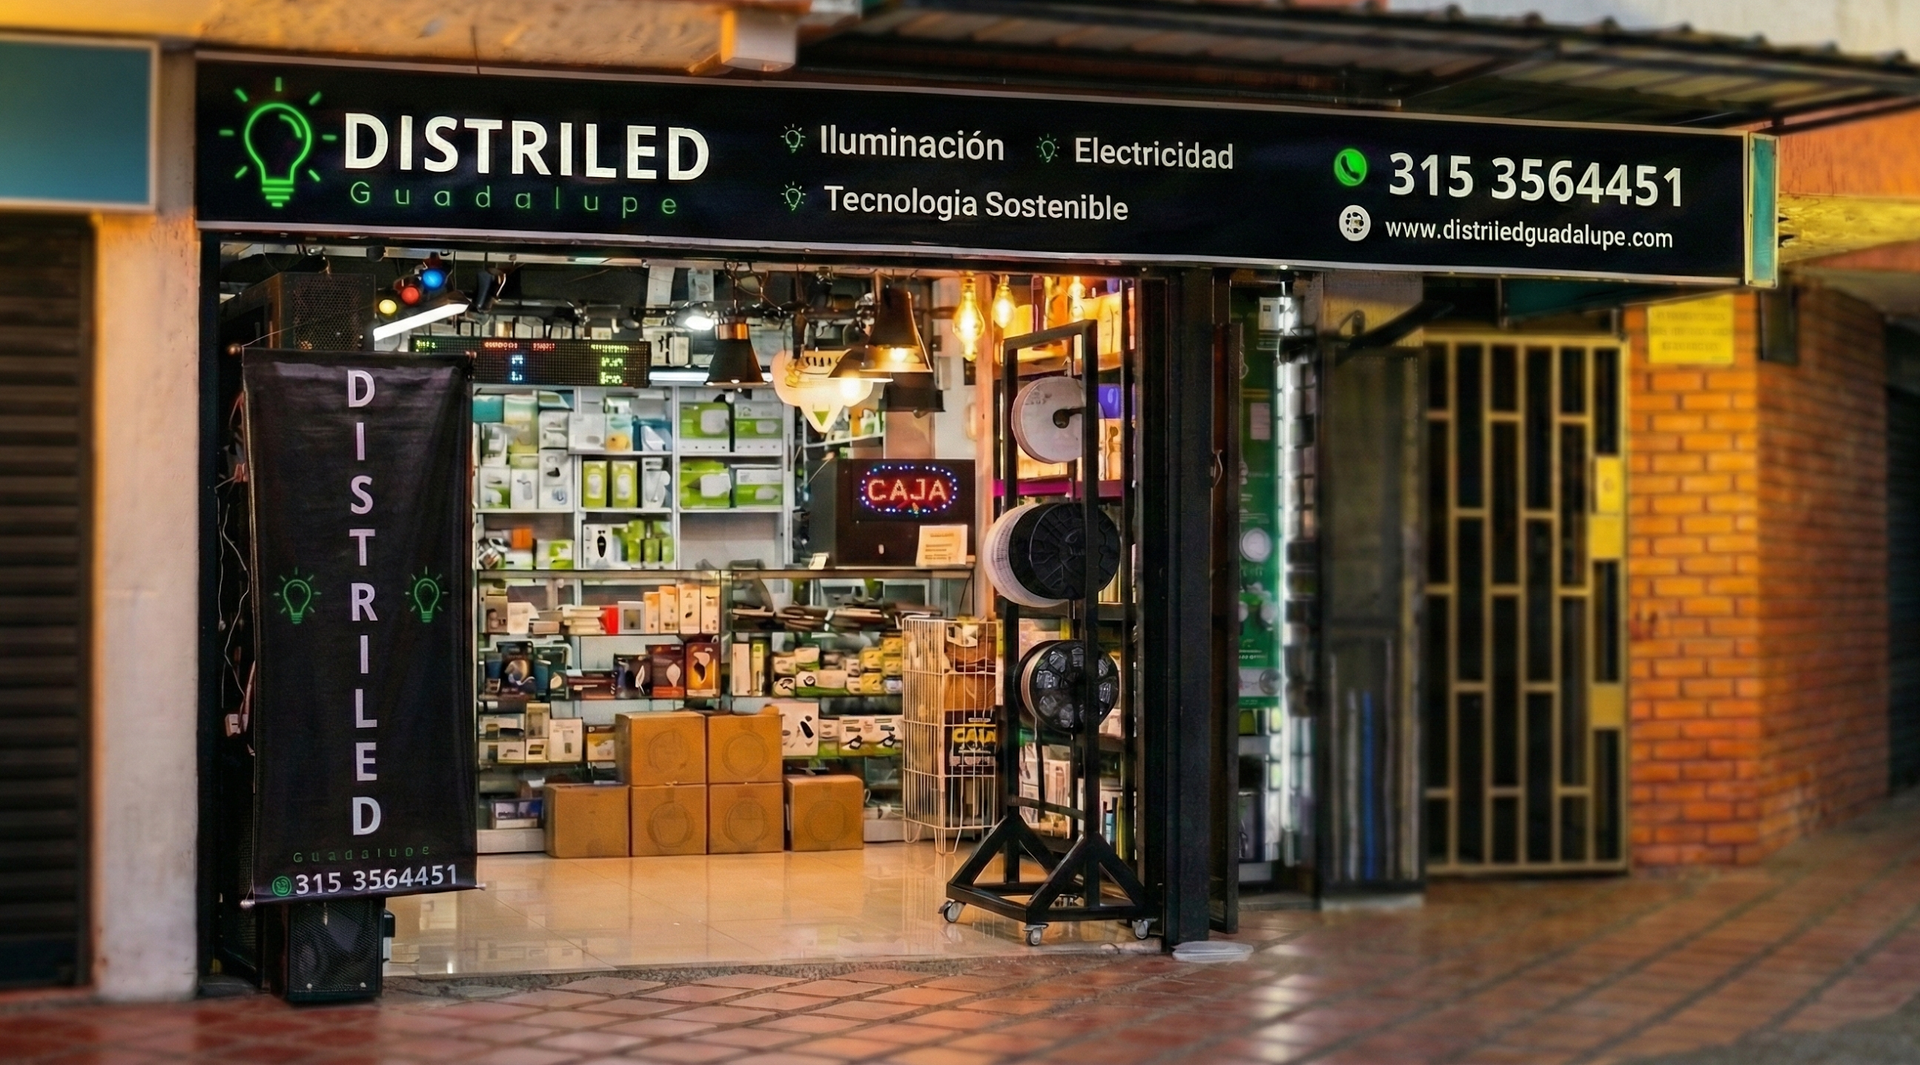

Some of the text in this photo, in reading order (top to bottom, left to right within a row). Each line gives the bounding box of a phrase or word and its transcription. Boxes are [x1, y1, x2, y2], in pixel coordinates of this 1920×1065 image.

[344, 112, 710, 181] DISTRILED
[820, 124, 1233, 170] Iluminación Electricidad
[350, 179, 678, 217] Guadalupe
[1389, 152, 1681, 207] 315 3564451
[823, 185, 1129, 222] Tecnologia Sostenible
[867, 478, 947, 502] CAJA
[347, 369, 382, 836] DISTRILED
[295, 863, 457, 895] 315 3564451
